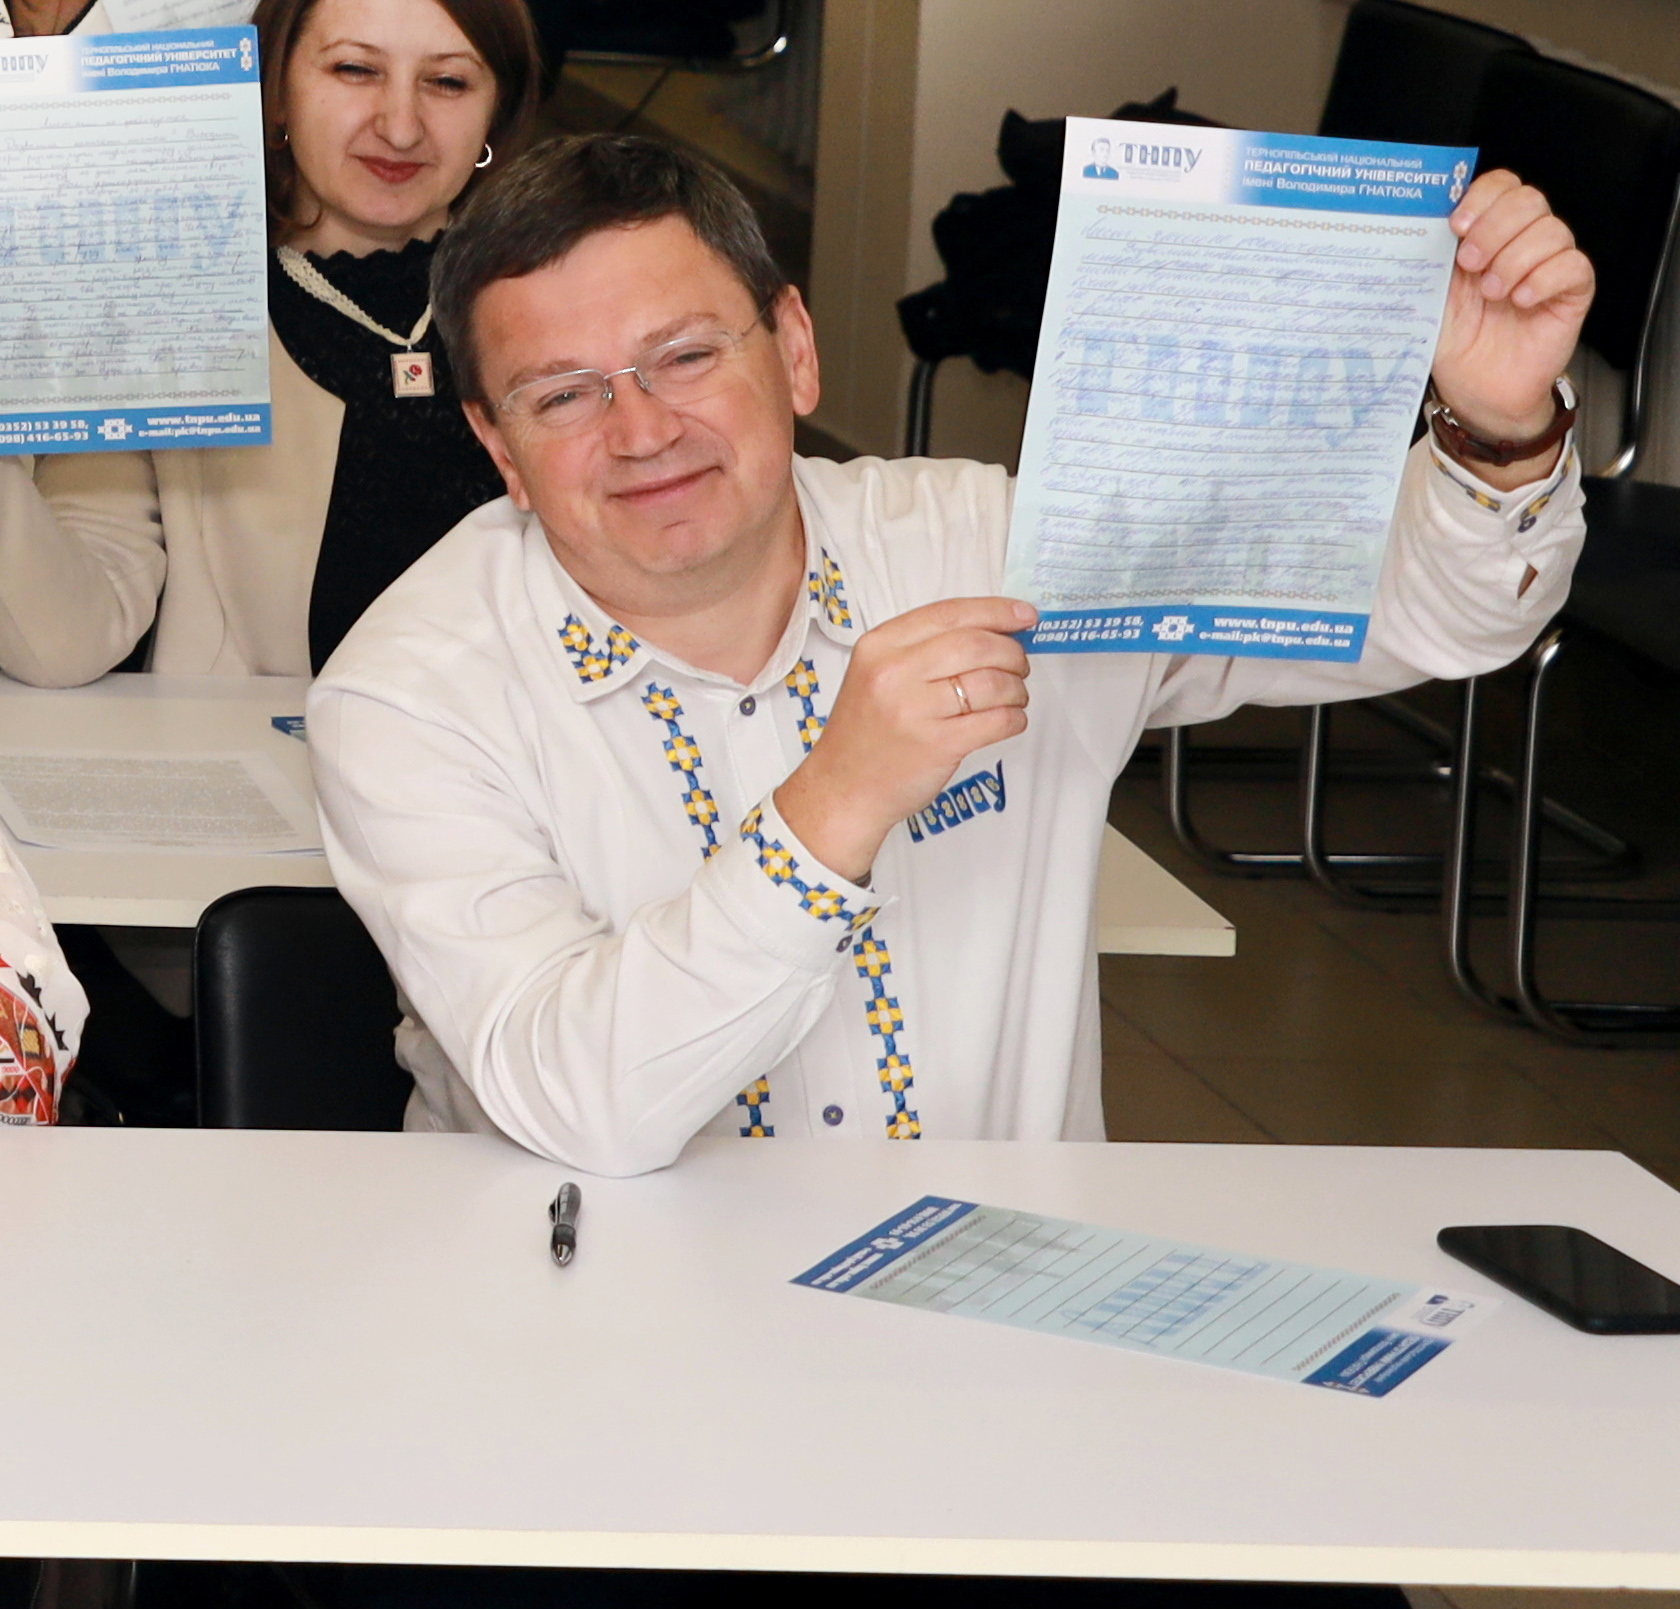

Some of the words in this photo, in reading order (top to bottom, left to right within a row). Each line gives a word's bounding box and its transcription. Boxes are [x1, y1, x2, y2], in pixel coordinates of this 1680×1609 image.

[81, 52, 163, 66] ПЕДАГОГІЧНИЙ
[164, 48, 237, 62] УНІВЕРСИТЕТ
[169, 61, 220, 74] ГНАТЮКА
[1119, 142, 1202, 173] ТНПУ
[1247, 148, 1338, 164] ТЕРНОПІЛЬСЬКИЙ
[1340, 153, 1422, 170] НАЦІОНАЛЬНИЙ
[1245, 159, 1352, 179] ПЕДАГОГІЧНИЙ
[1354, 168, 1449, 187] УНІВЕРСИТЕТ
[1243, 177, 1275, 190] імені
[1277, 178, 1356, 196] Володимира
[1358, 182, 1422, 199] ГНАТЮКА
[1056, 327, 1415, 447] ТНПУ
[34, 420, 50, 431] 53
[51, 420, 68, 431] 39
[69, 419, 89, 430] 58,
[147, 413, 261, 426] www.tnpu.edu.ua
[26, 431, 89, 444] 416-65-93
[1037, 617, 1082, 632] (0352)
[1104, 617, 1121, 628] 39
[1124, 616, 1145, 628] 58,
[1214, 616, 1354, 634] www.tnpu.edu.ua
[1032, 629, 1068, 644] (098)
[1070, 628, 1140, 641] 416-65-93
[1199, 630, 1350, 647] e-mail:pk@tnpu.edu.ua
